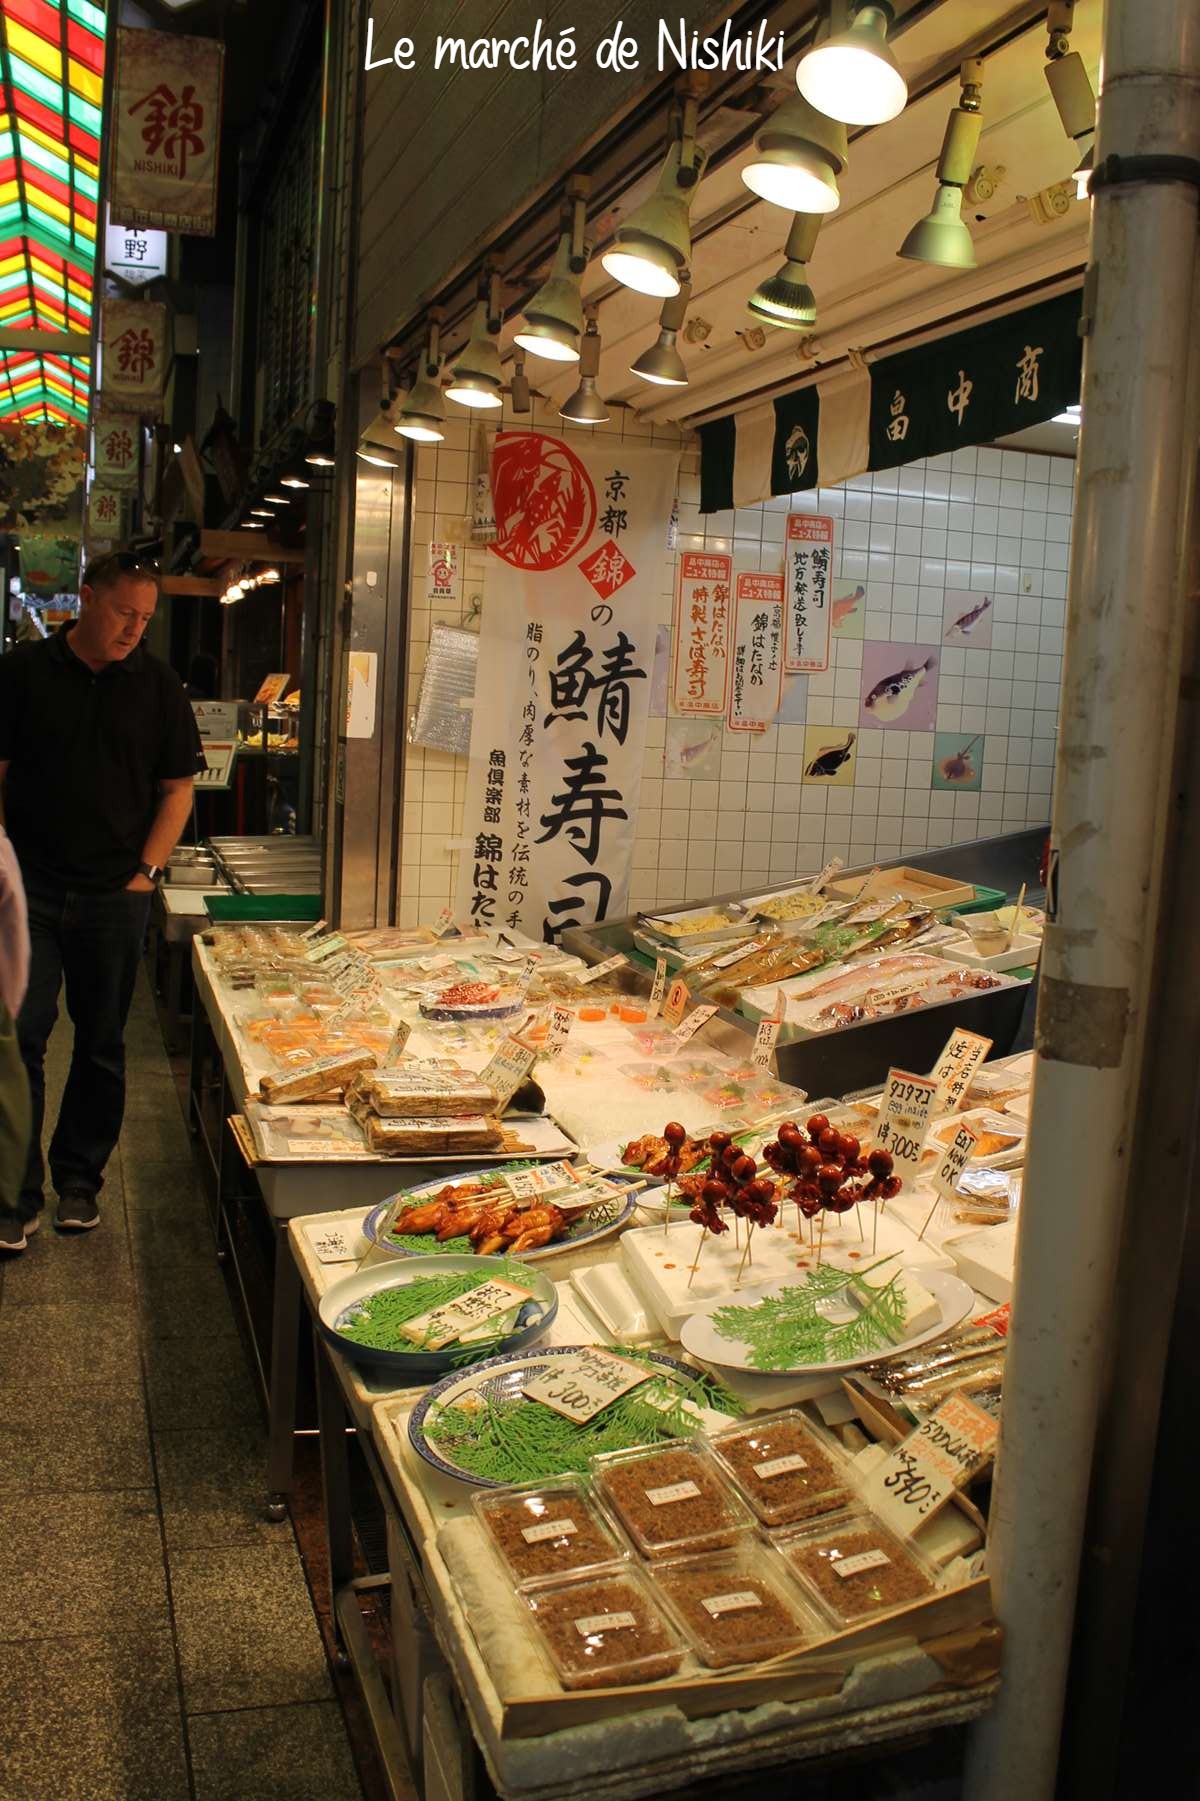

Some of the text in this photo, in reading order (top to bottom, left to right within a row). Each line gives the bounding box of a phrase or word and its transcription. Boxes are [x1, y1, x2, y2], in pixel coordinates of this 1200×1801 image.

[128, 83, 205, 180] 錦
[134, 159, 178, 177] NISHIKI
[109, 327, 155, 385] 錦
[599, 470, 630, 538] 京都
[889, 1079, 937, 1105] タコタマゴ
[954, 1128, 975, 1152] EAT
[947, 1148, 967, 1168] NOW
[941, 1164, 958, 1186] OK
